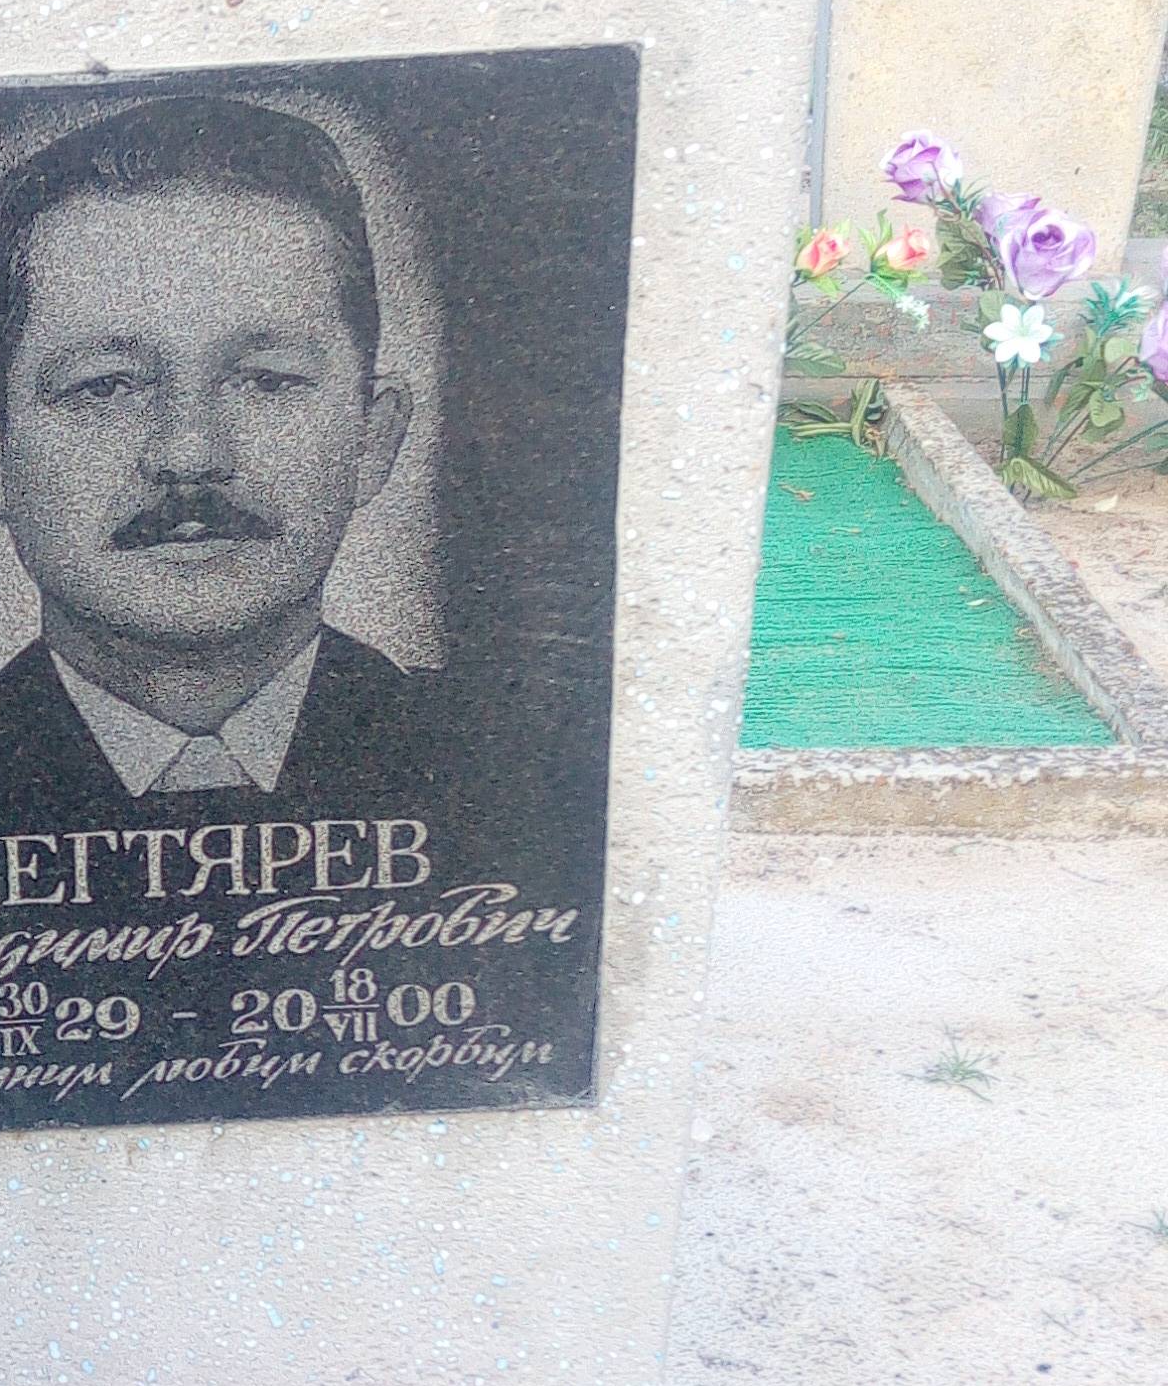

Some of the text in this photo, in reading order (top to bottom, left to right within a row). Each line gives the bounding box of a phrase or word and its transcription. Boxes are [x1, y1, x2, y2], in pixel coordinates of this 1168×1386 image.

[232, 883, 581, 966] Петрович
[331, 969, 378, 1004] 18
[386, 982, 476, 1026] 00
[55, 996, 140, 1040] 29
[231, 989, 317, 1033] 20
[322, 1012, 379, 1043] VII
[119, 1038, 323, 1101] любим
[338, 1023, 554, 1084] скорбим
